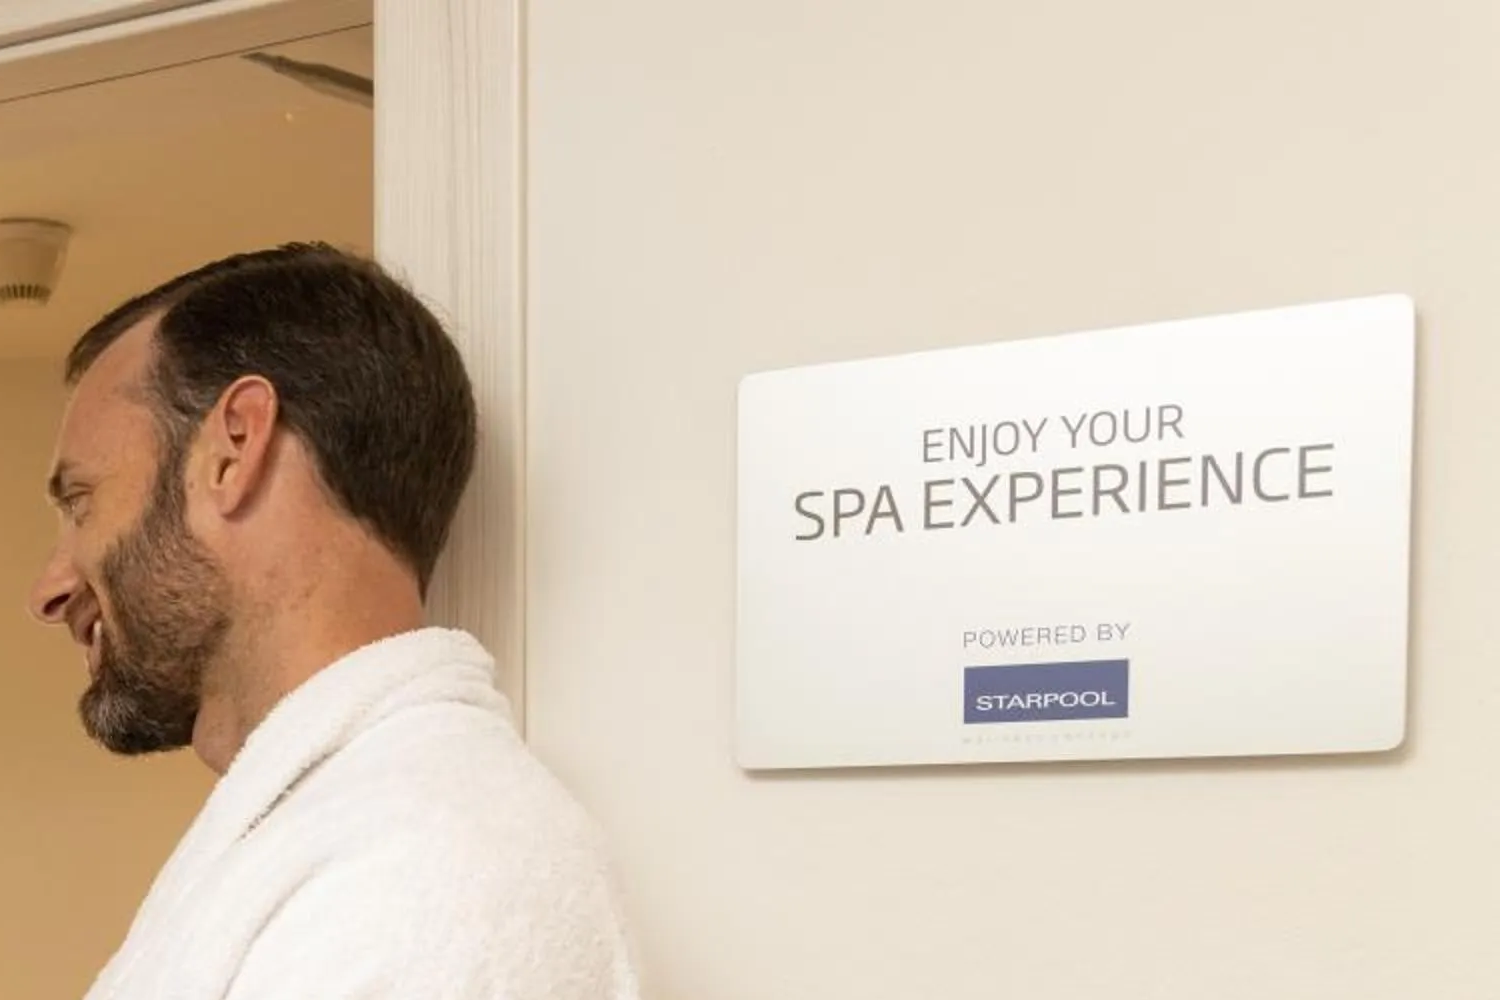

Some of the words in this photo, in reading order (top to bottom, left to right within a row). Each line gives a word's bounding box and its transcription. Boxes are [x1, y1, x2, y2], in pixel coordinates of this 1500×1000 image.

[922, 417, 1047, 467] ENJOY
[1061, 404, 1185, 450] YOUR
[794, 484, 905, 542] SPA
[923, 442, 1335, 531] EXPERIENCE
[963, 624, 1087, 649] POWERED
[1097, 622, 1132, 642] BY
[975, 691, 1116, 711] STARPOOL
